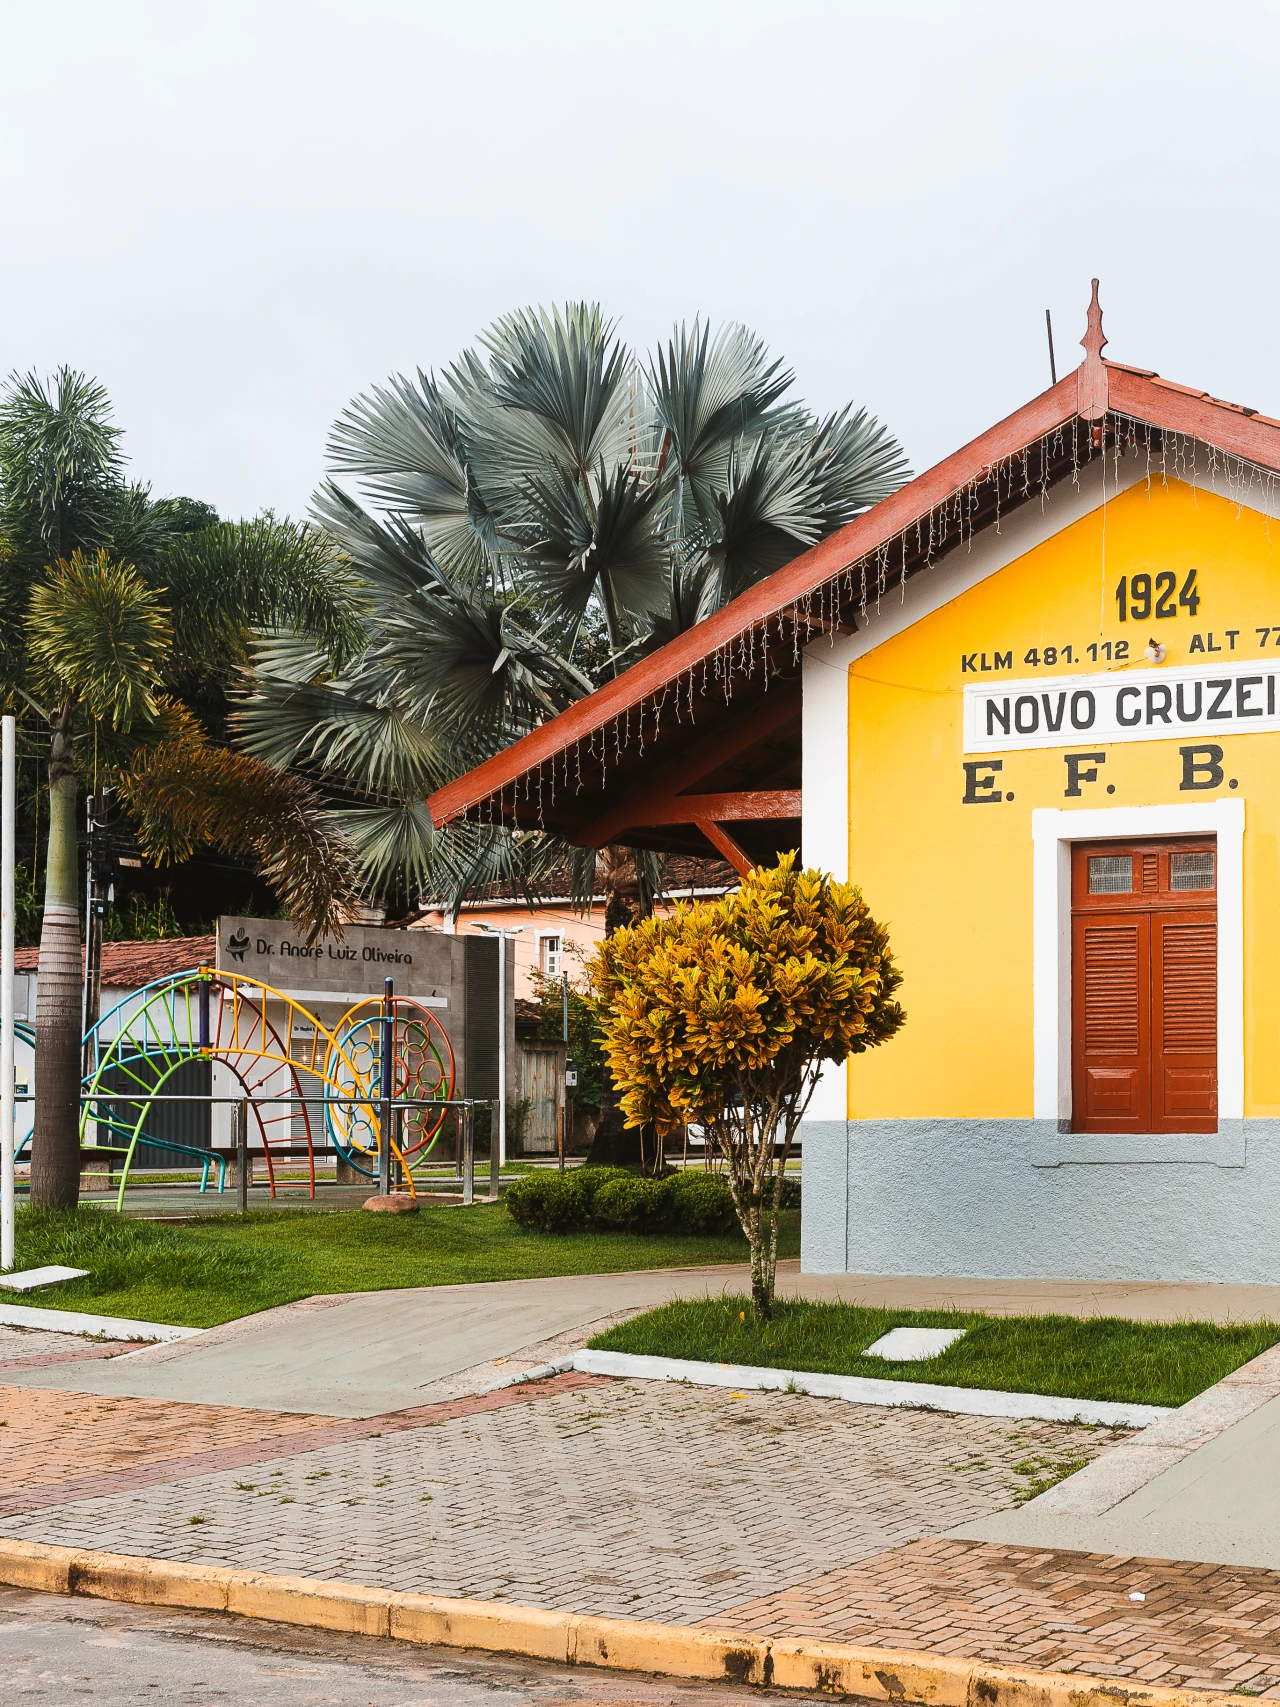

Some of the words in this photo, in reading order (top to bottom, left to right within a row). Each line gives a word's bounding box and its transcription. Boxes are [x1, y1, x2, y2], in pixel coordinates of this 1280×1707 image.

[1115, 568, 1200, 622] 1924
[961, 650, 1013, 673] KLM
[1023, 640, 1129, 667] 481.112
[1189, 630, 1240, 654] ALT
[986, 690, 1096, 736] NOVO
[962, 759, 1015, 804] E.
[1064, 752, 1116, 797] F.
[1179, 744, 1239, 791] B.
[256, 939, 275, 955] Dr.
[328, 944, 357, 961] Luiz
[362, 946, 412, 964] Oliveira
